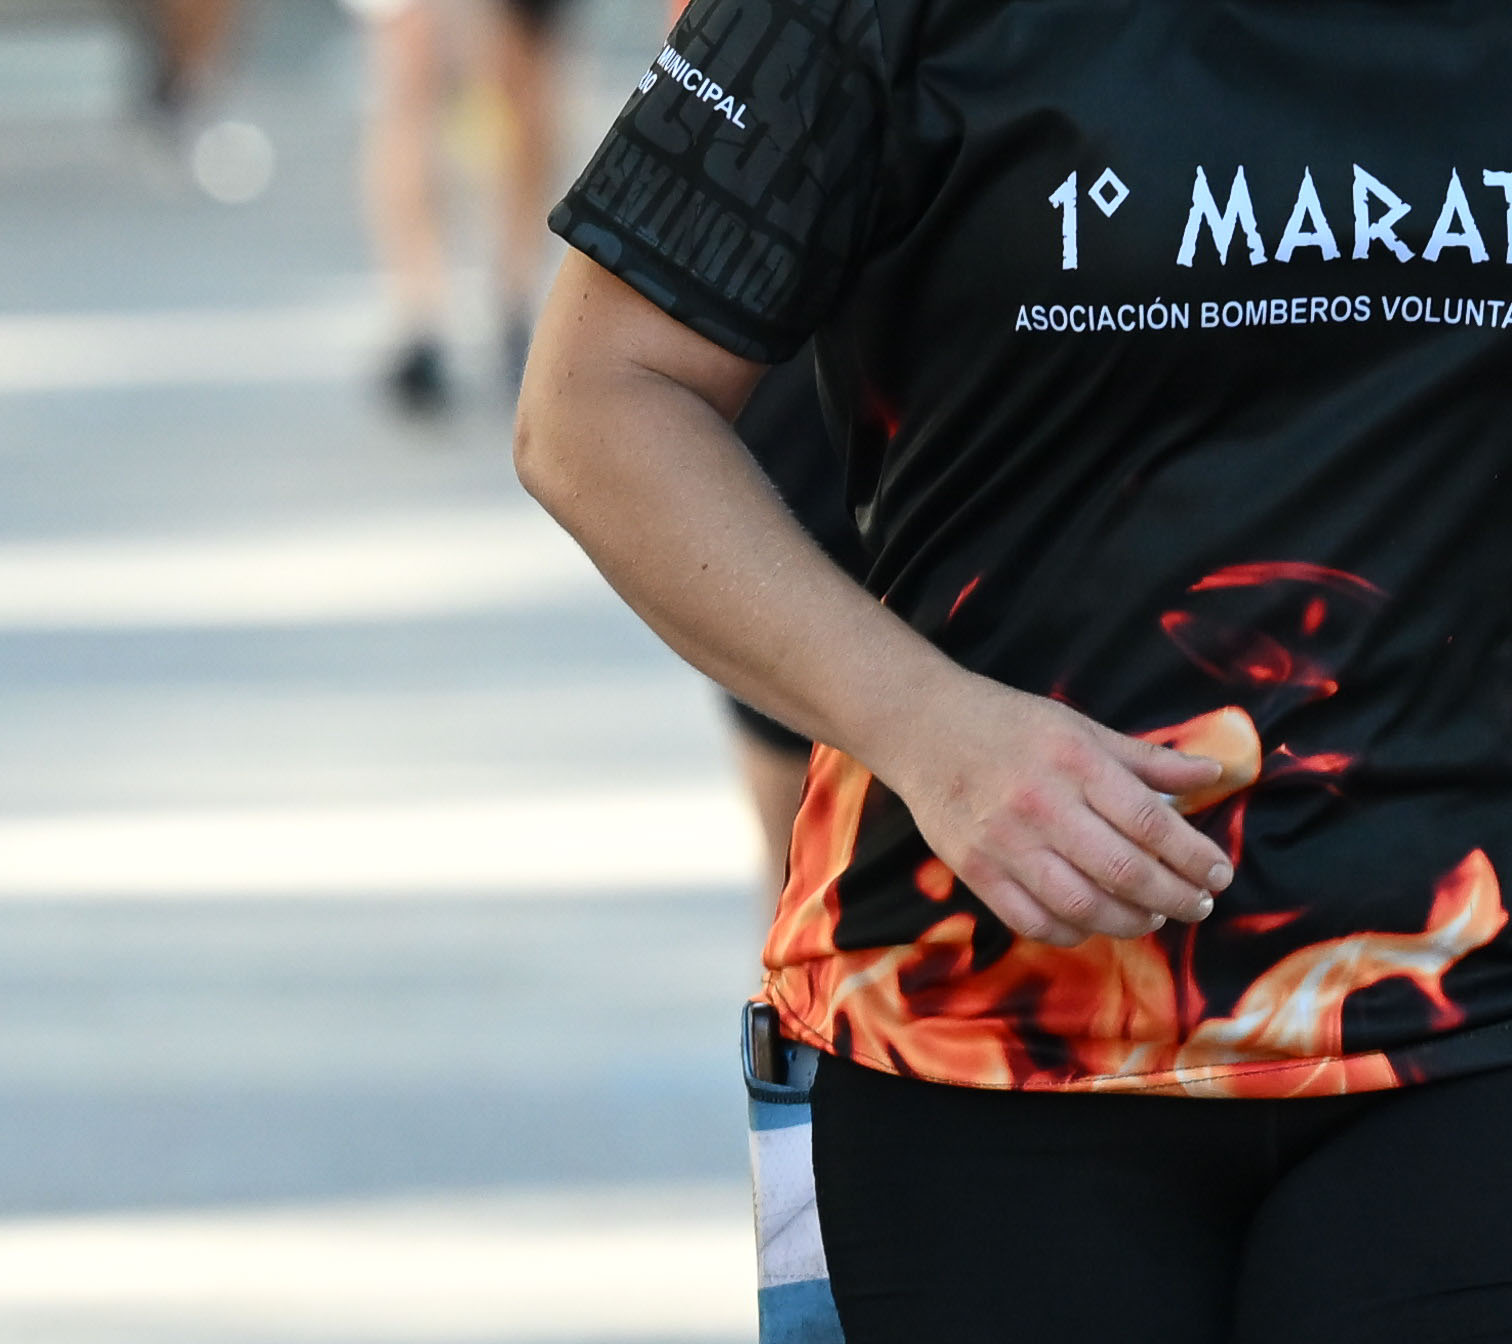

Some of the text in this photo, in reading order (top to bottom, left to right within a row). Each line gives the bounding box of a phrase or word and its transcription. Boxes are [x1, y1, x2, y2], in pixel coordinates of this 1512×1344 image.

[657, 43, 747, 129] MUNICIPAL
[1015, 297, 1189, 332] ASOCIACIÓN
[1200, 296, 1371, 328] BOMBEROS
